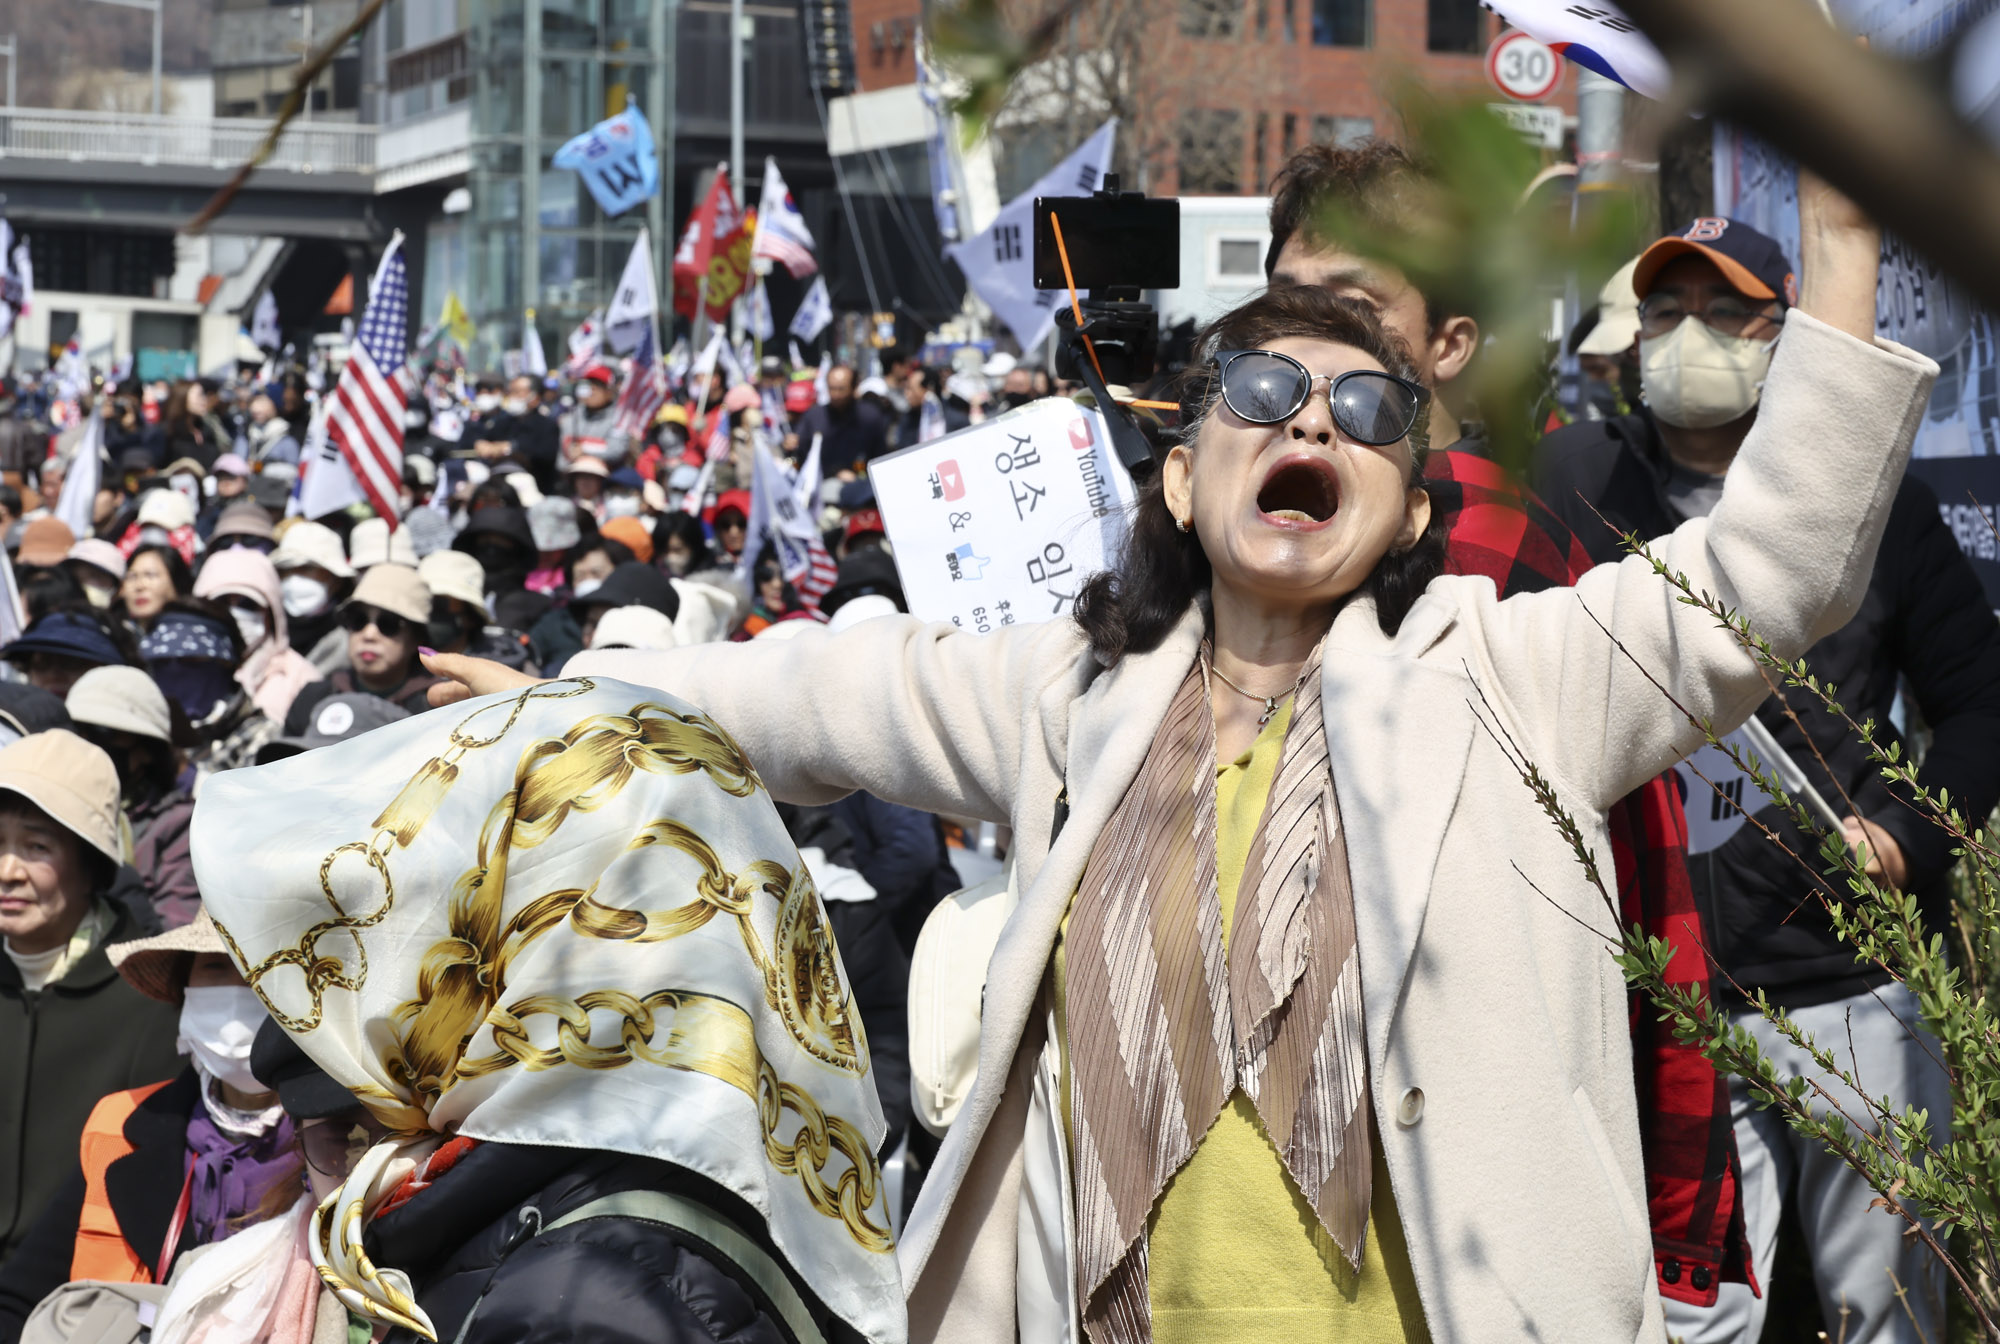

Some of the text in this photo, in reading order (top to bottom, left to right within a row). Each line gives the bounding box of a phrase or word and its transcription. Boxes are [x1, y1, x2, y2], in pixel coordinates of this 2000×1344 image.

[1504, 49, 1548, 82] 30
[1682, 216, 1729, 241] B
[996, 434, 1046, 521] 생소
[1077, 449, 1112, 519] YouTube
[948, 511, 972, 533] &
[972, 607, 991, 634] 650
